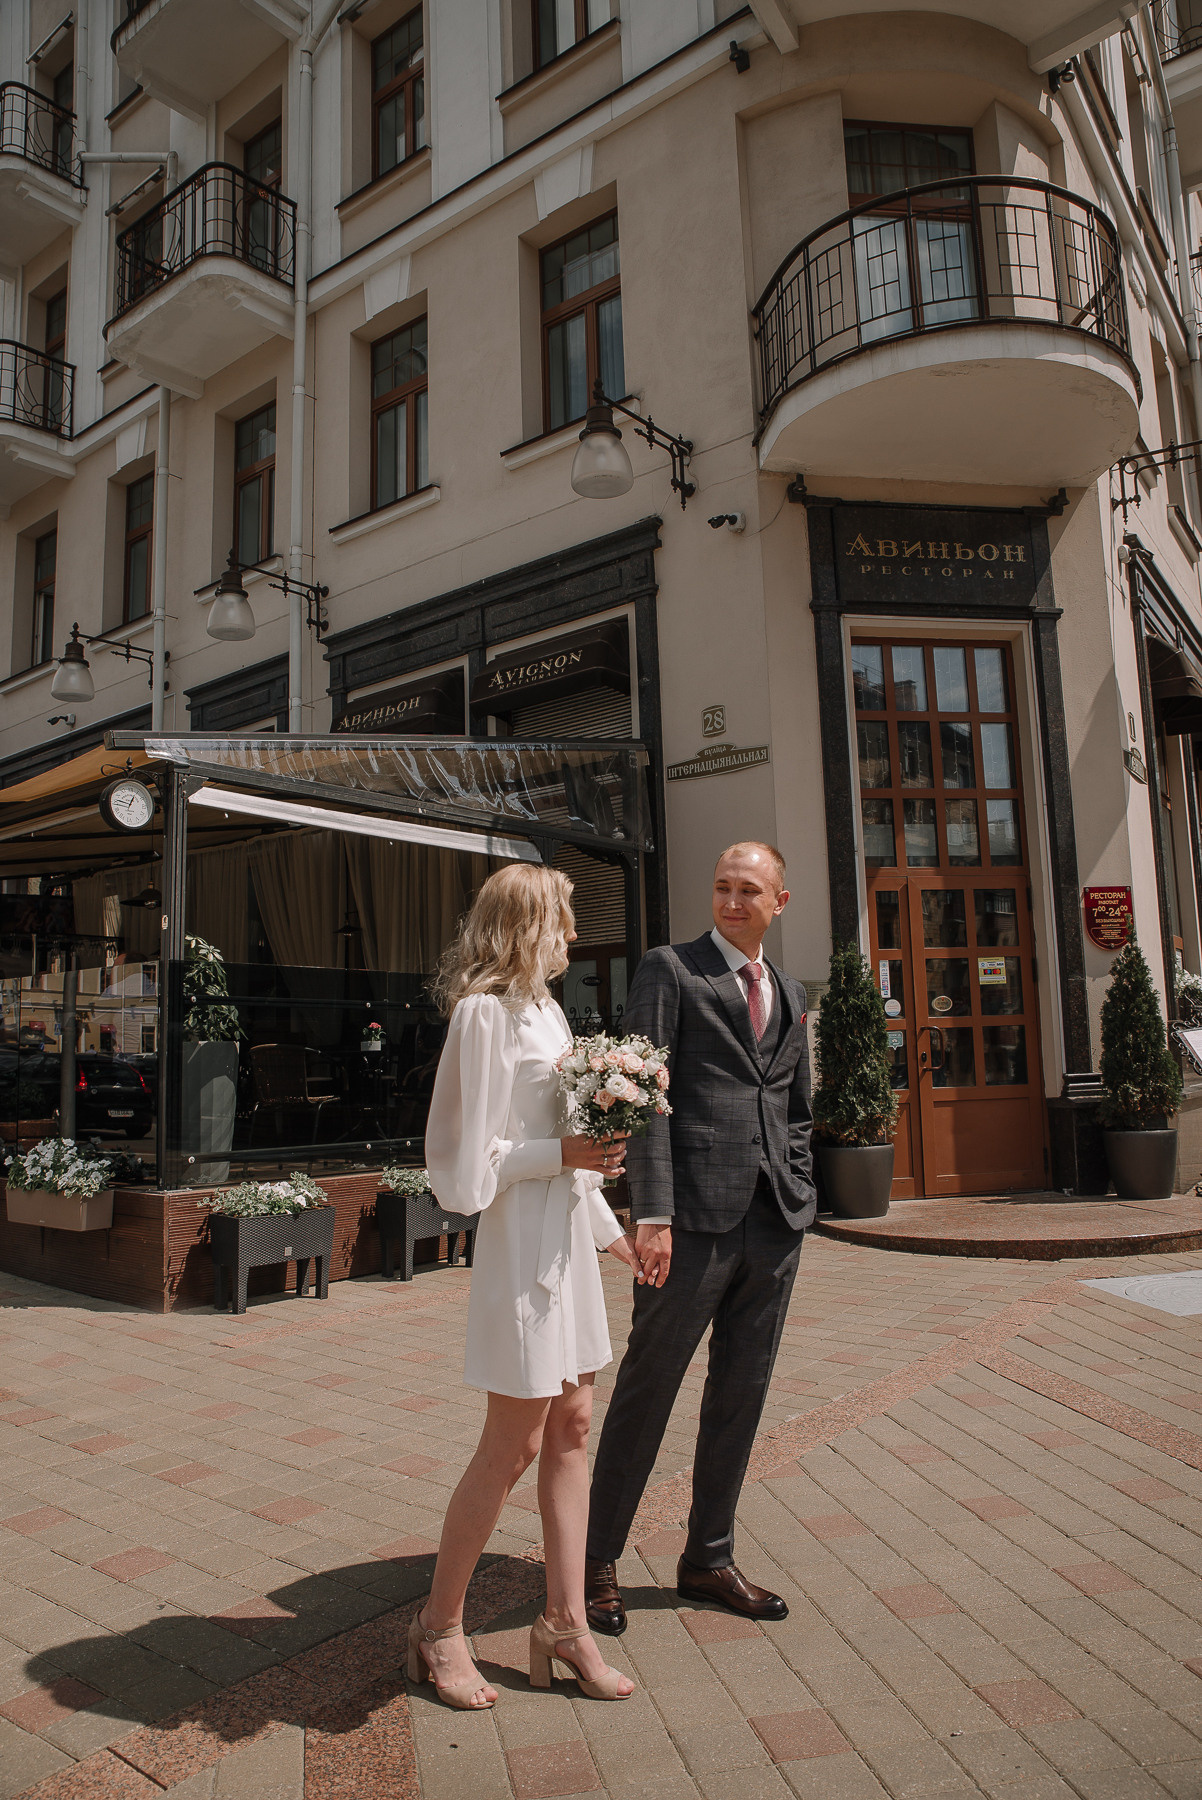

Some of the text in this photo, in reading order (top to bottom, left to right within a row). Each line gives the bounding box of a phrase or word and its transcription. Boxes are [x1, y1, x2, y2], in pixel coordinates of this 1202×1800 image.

[861, 565, 1015, 579] РЕСТОРАН
[488, 650, 583, 688] AVIGNON
[703, 711, 724, 732] 28
[1090, 892, 1127, 900] РЕСТОРАН
